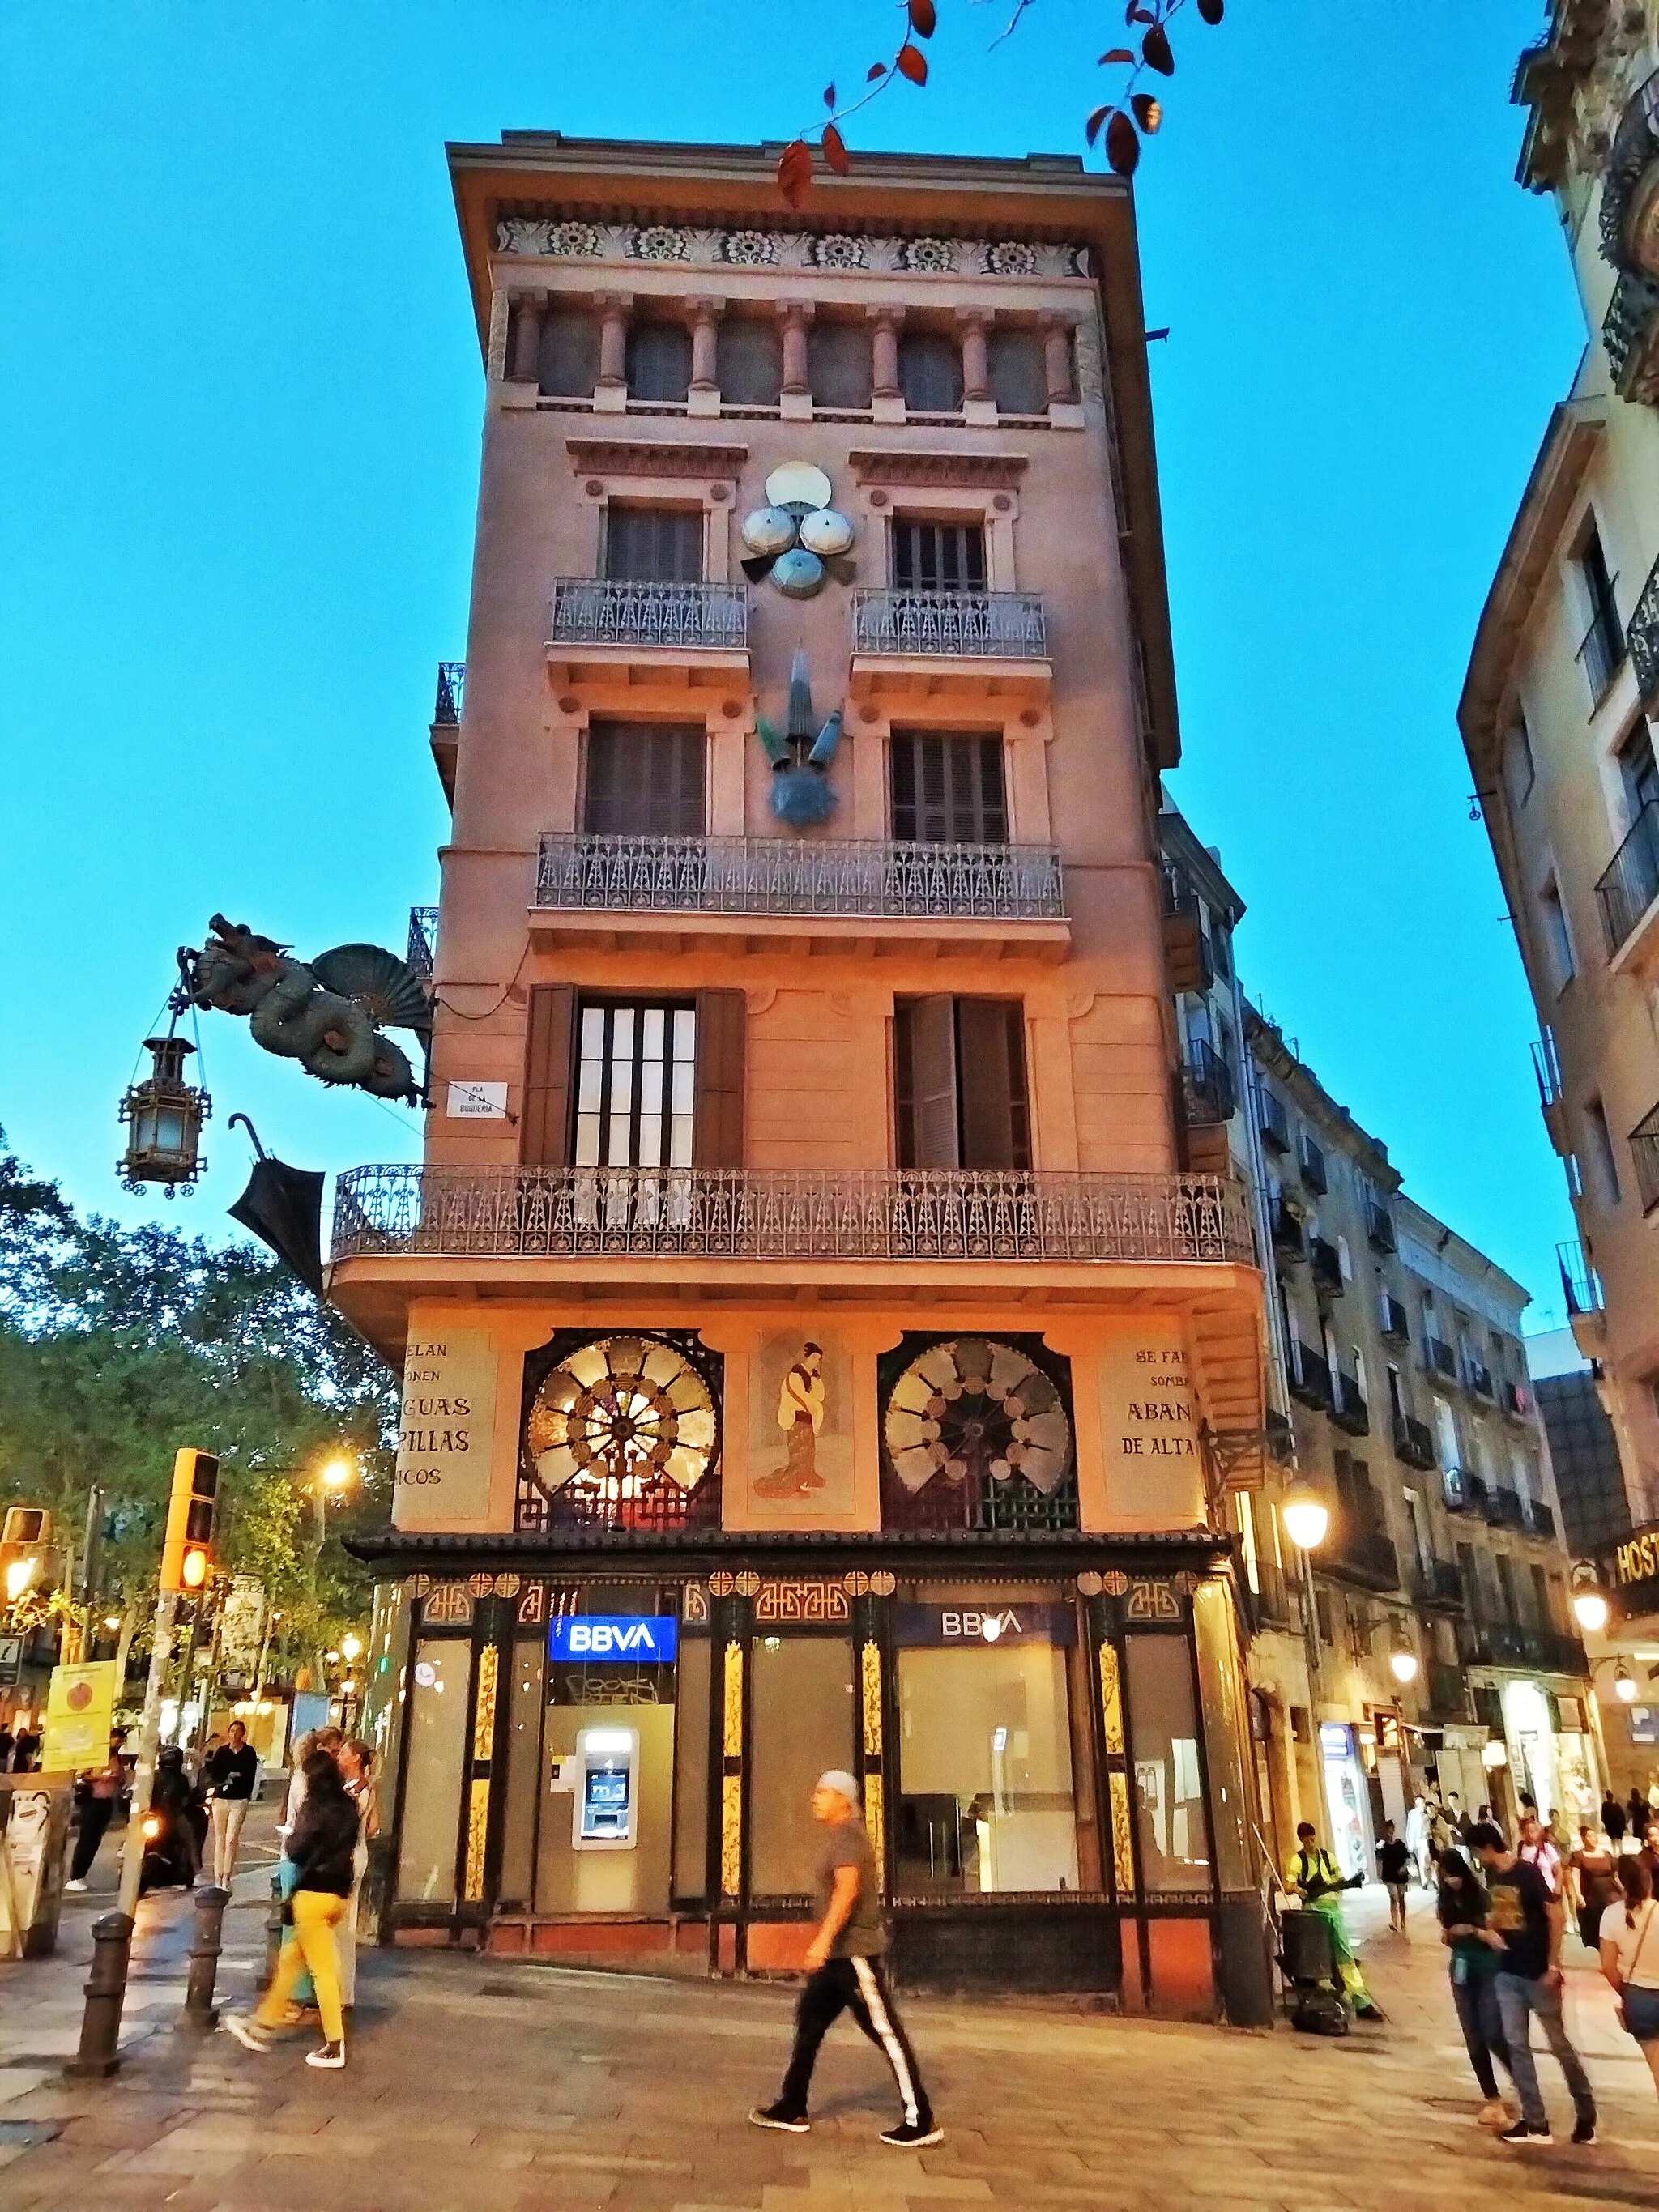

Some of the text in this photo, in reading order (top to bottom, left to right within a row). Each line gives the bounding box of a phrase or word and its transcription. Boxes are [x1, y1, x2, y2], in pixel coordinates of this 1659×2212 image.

[460, 1105, 493, 1113] BOQUERIA
[1136, 1350, 1157, 1363] SE
[1128, 1403, 1191, 1421] ABAN
[1122, 1438, 1143, 1455] DE
[569, 1622, 655, 1652] BBVA
